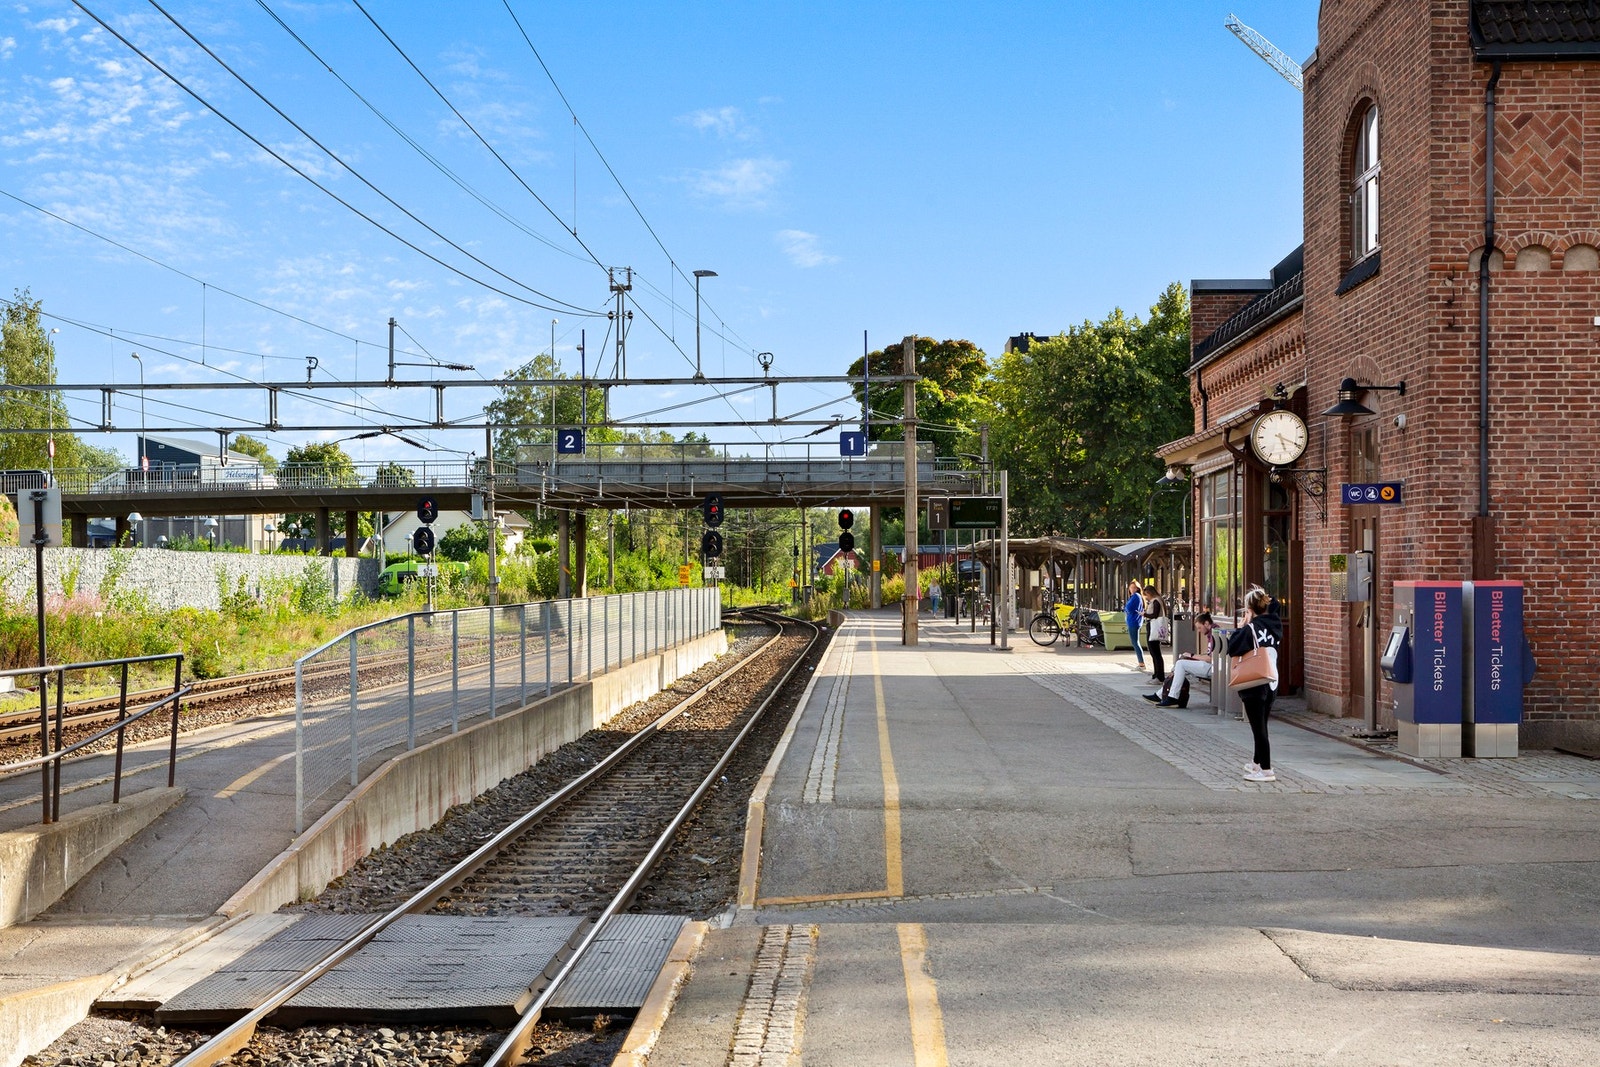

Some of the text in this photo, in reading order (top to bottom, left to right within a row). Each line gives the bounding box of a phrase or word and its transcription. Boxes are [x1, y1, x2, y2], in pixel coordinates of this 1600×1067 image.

[564, 435, 575, 448] 2
[848, 437, 854, 451] 1
[936, 513, 940, 523] 1
[1433, 591, 1446, 691] Billetter Tickets
[1491, 591, 1504, 691] Billetter Tickets
